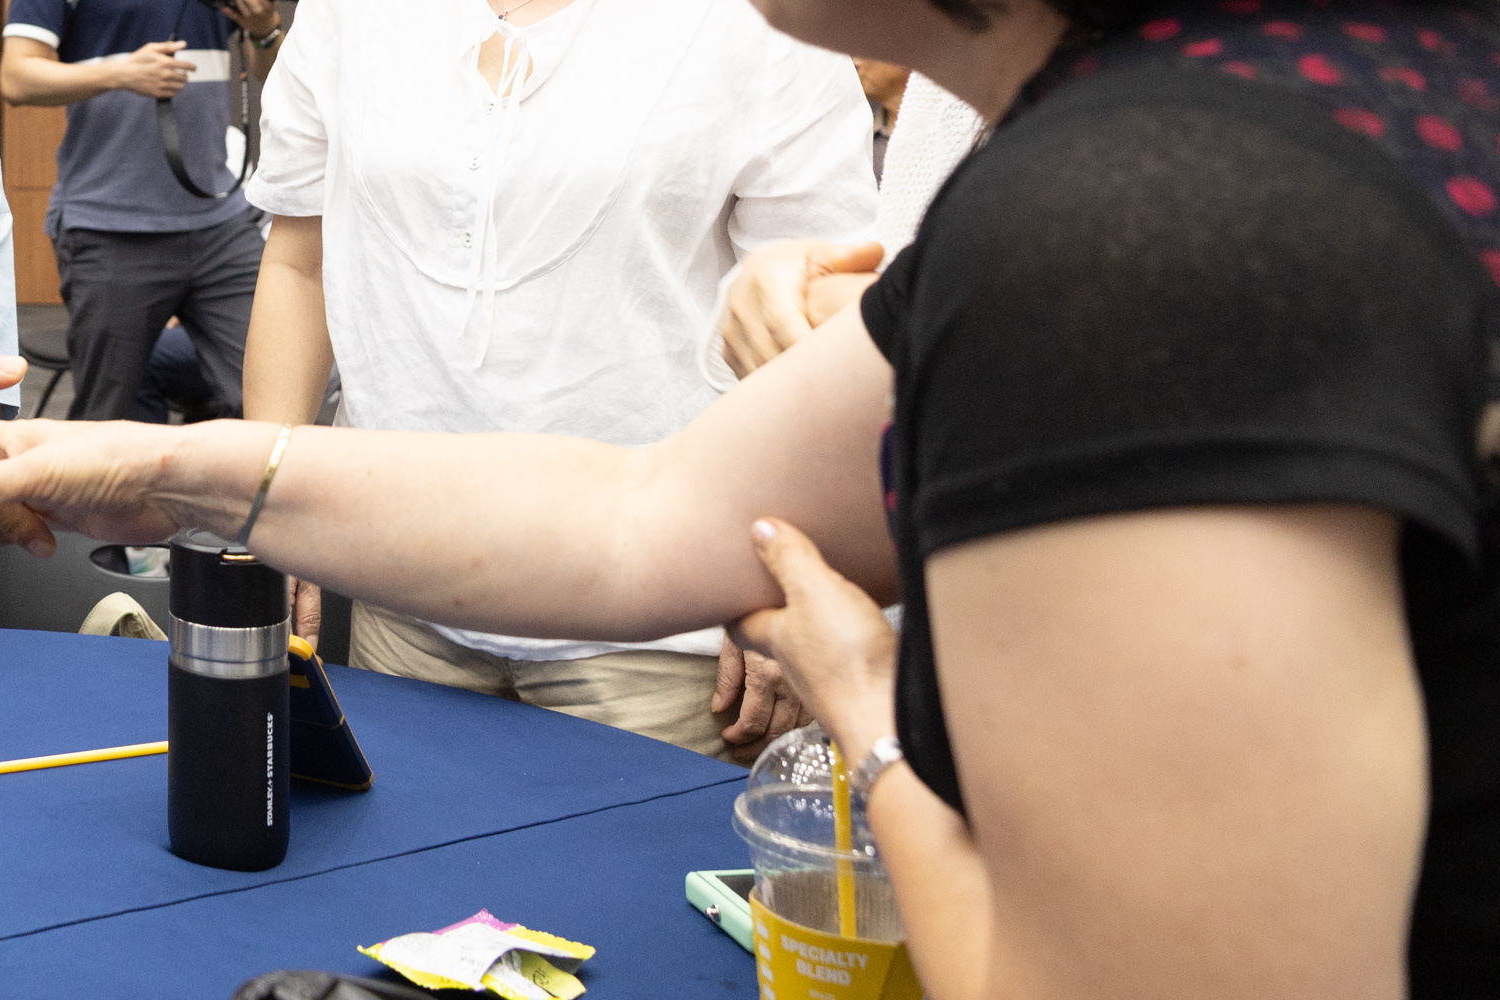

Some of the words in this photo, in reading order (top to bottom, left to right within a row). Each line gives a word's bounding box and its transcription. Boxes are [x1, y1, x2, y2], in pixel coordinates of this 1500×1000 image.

[266, 712, 274, 778] STARBUCKS
[781, 934, 869, 970] SPECIALTY
[796, 958, 851, 986] BLEND
